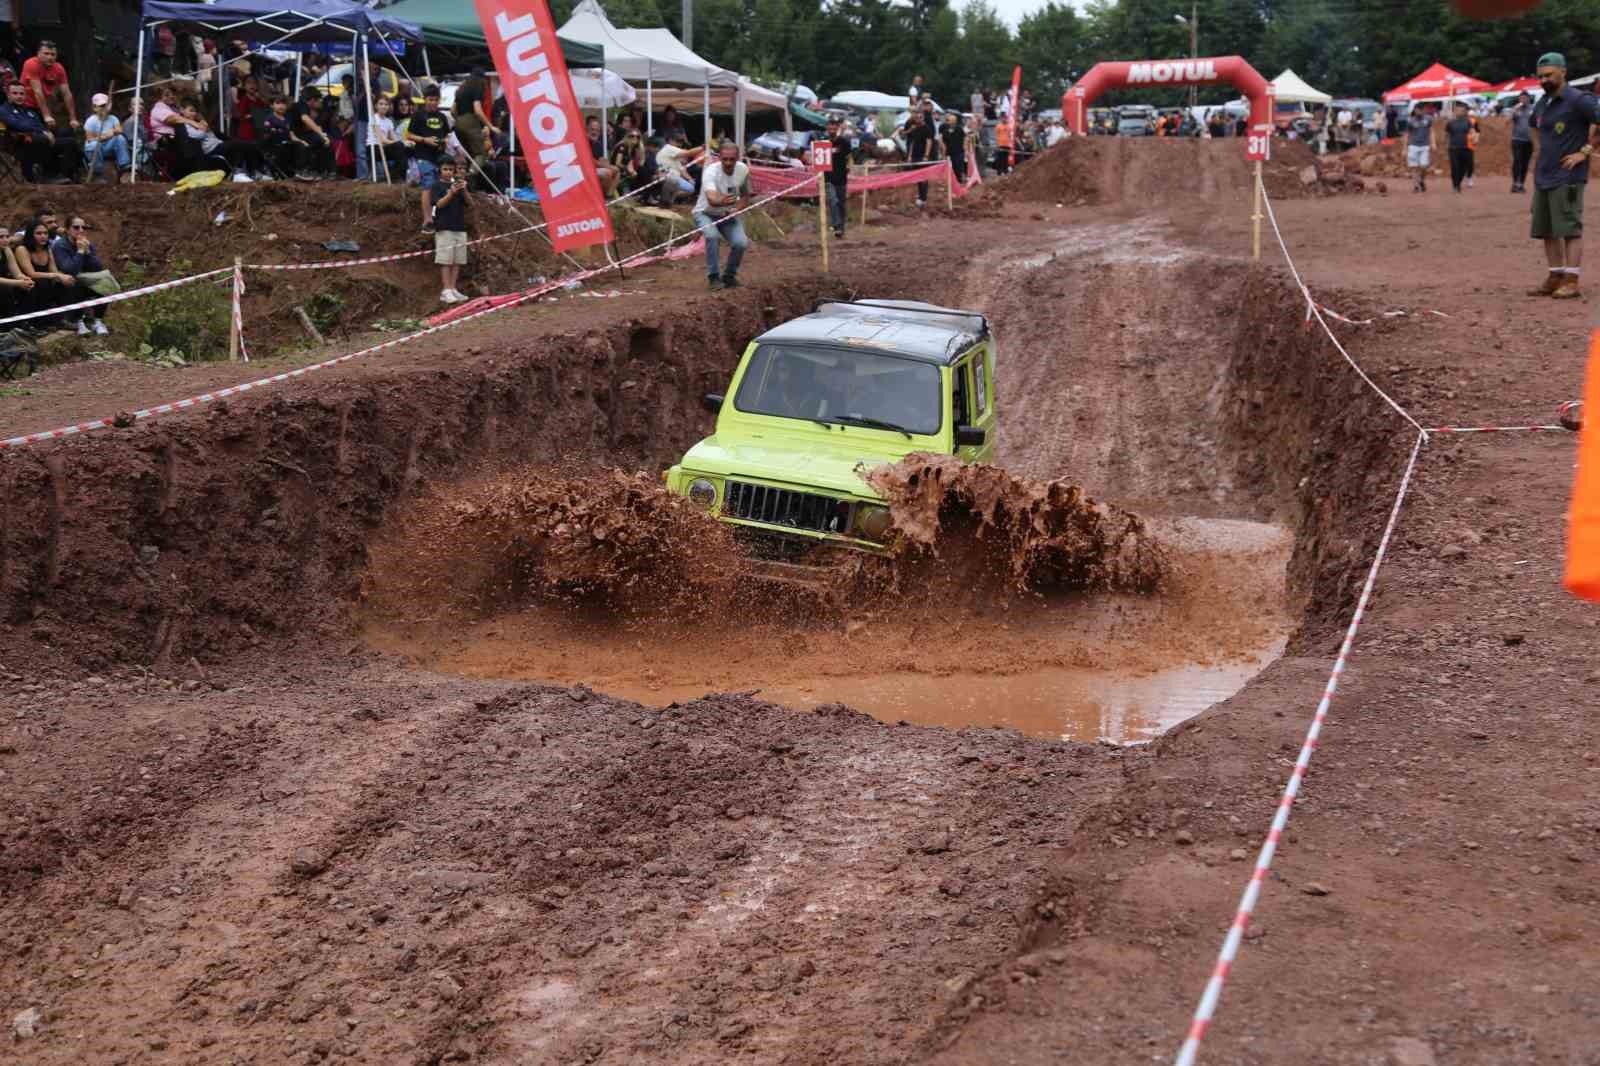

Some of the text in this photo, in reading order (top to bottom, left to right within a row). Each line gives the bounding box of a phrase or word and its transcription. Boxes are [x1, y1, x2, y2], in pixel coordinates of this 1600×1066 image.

[1127, 61, 1217, 83] MOTUL
[1248, 135, 1265, 154] 31
[815, 147, 831, 165] 31
